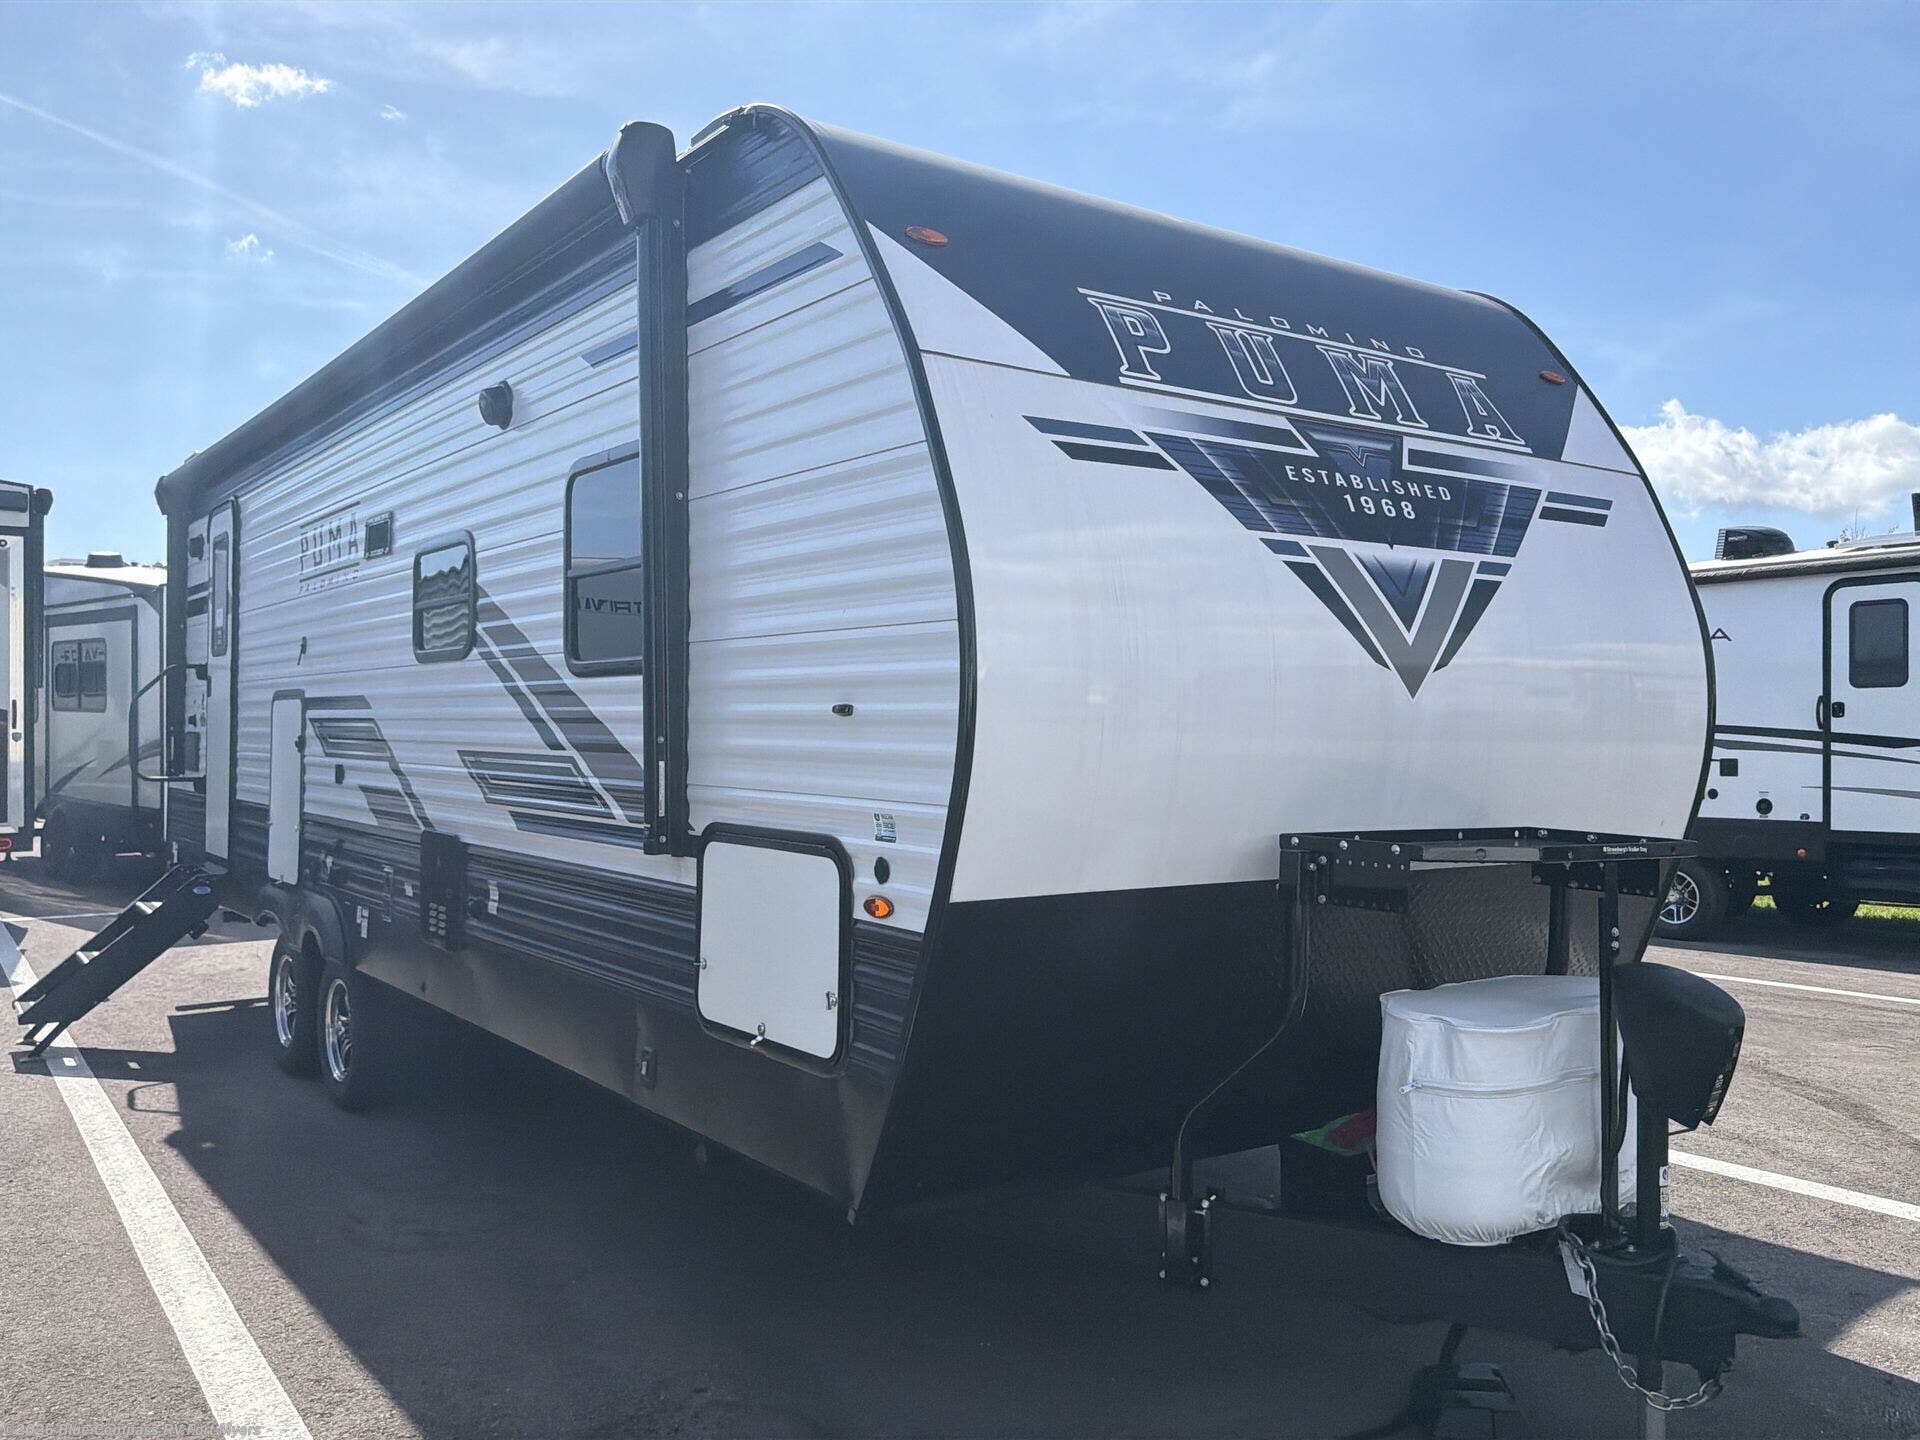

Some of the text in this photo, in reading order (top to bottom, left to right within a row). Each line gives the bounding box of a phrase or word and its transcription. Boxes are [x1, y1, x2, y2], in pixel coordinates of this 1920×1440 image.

[1152, 290, 1426, 359] PALOMINO
[1087, 297, 1526, 445] PUMA
[1285, 465, 1452, 501] ESTABLISHED
[1343, 494, 1416, 519] 1968
[300, 511, 359, 575] PUMA
